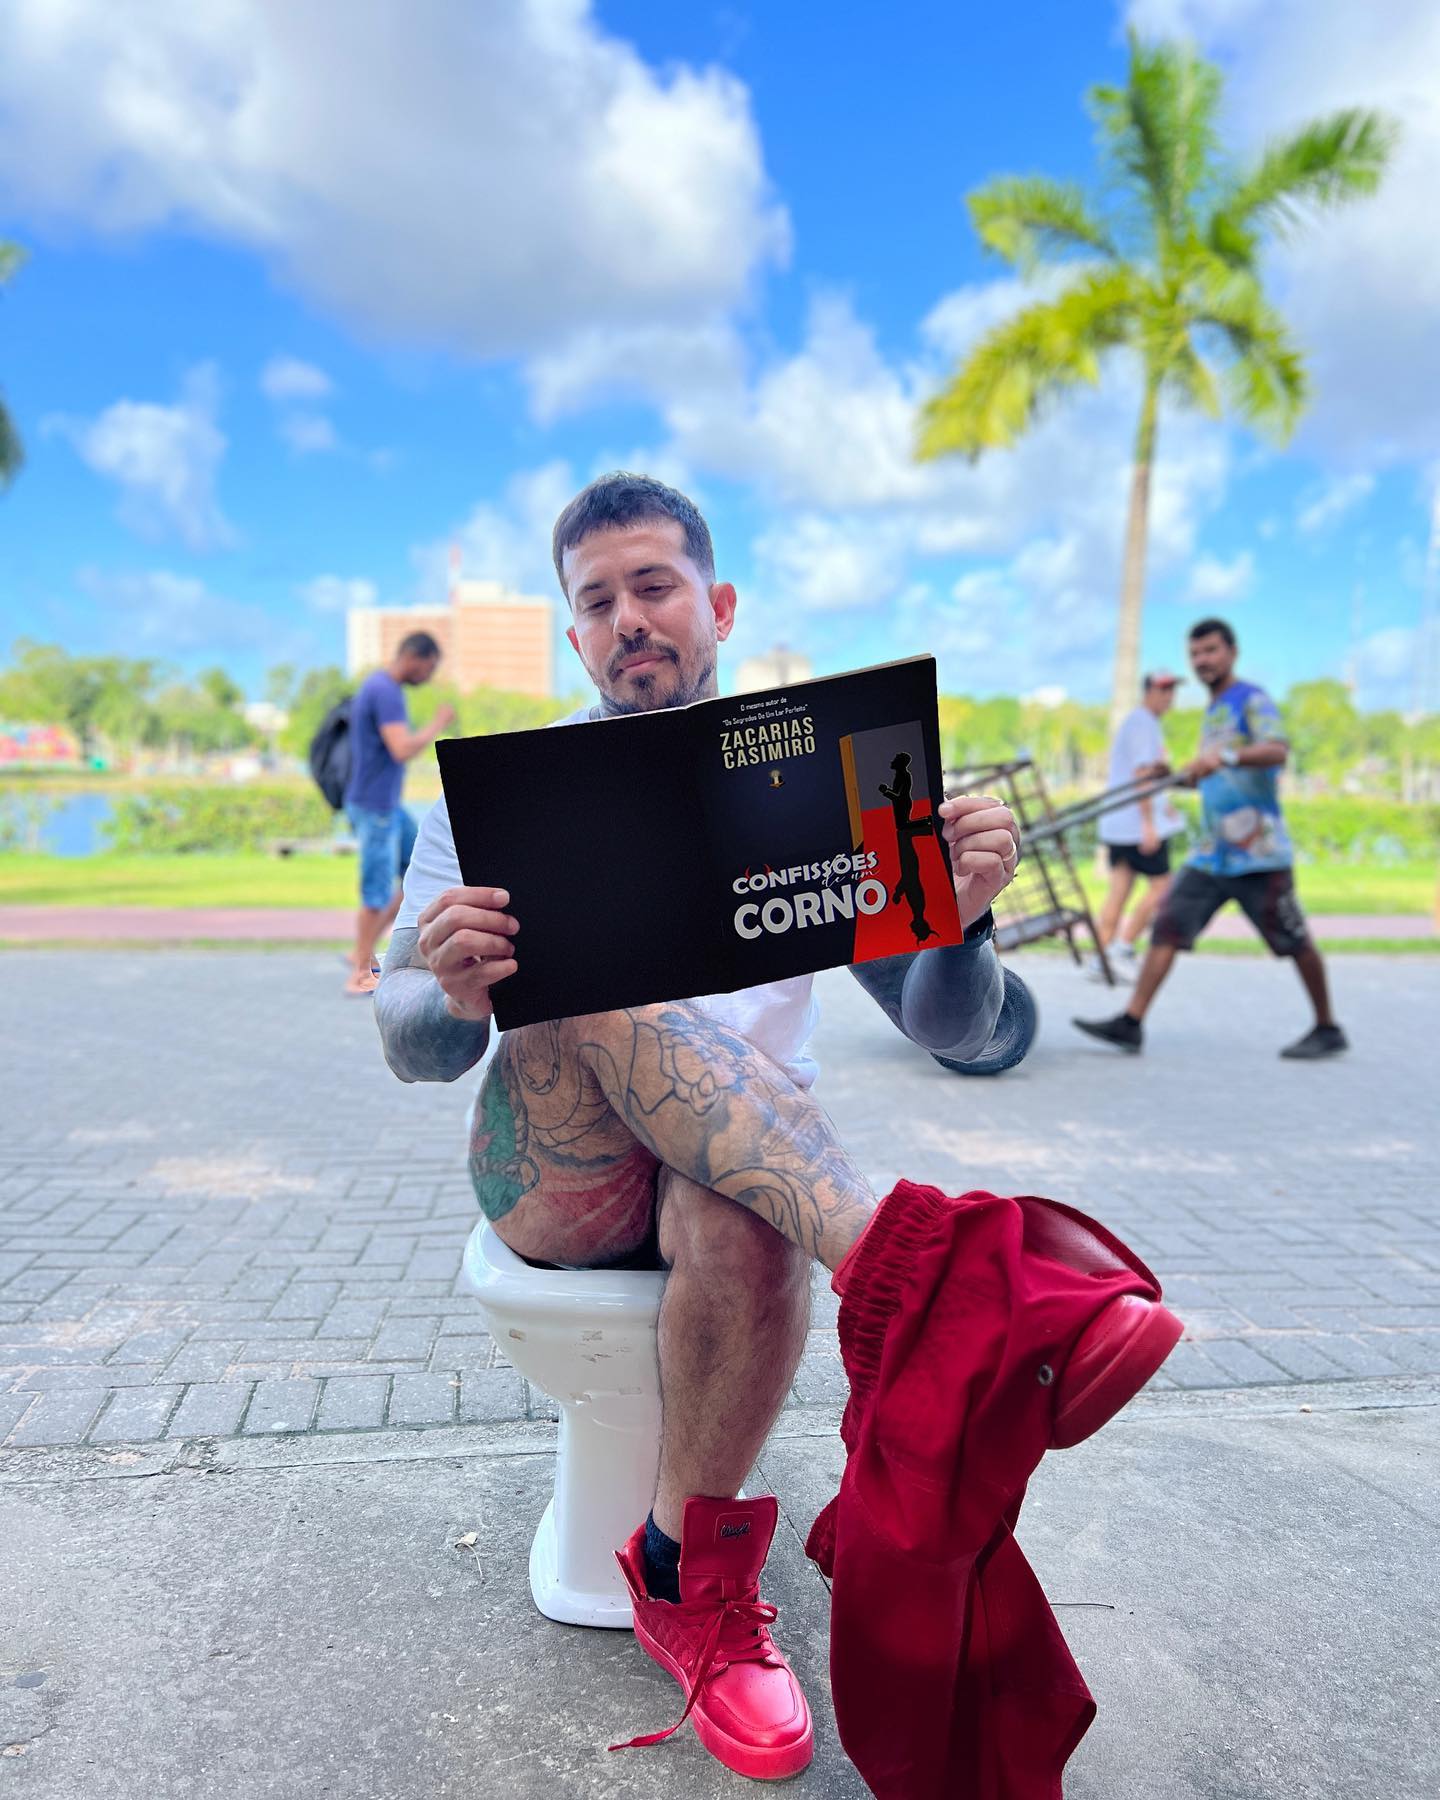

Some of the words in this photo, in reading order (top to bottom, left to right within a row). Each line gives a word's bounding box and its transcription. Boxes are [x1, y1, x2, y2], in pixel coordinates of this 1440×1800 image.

[720, 717, 814, 751] ZACARIAS
[733, 715, 757, 725] Segredos
[724, 736, 815, 769] CASIMIRO
[732, 851, 877, 894] CONFISSÕES
[734, 879, 887, 939] CORNO
